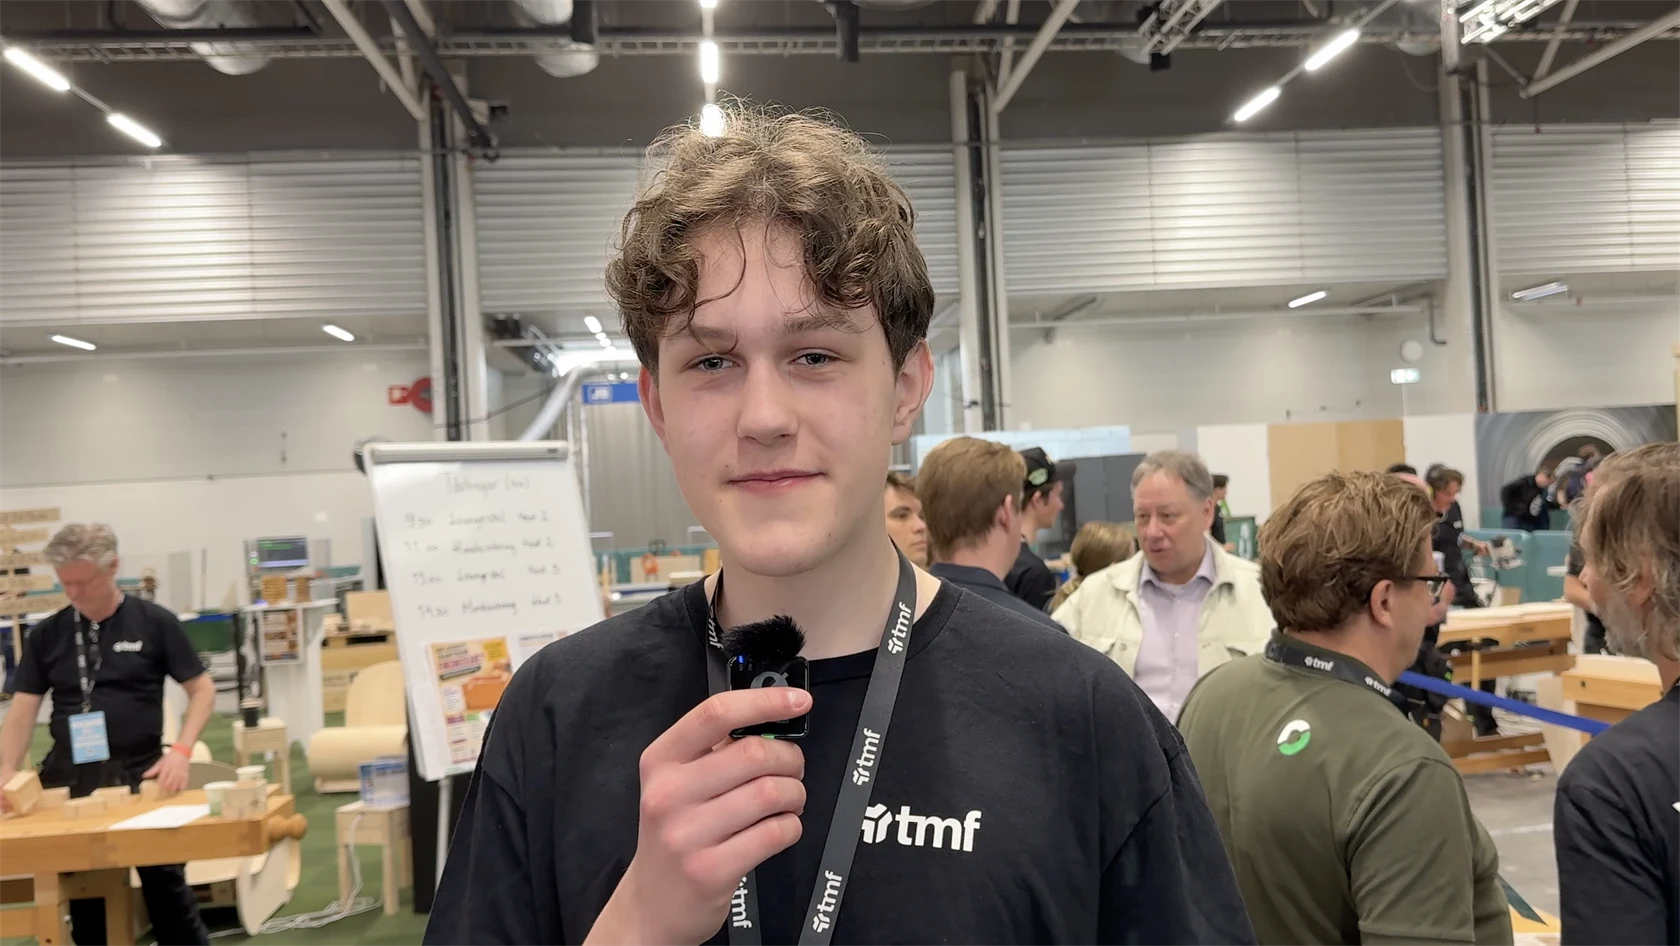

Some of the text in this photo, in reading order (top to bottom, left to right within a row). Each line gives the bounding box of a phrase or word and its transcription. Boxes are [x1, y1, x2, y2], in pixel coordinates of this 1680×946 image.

[891, 602, 911, 639] tmf
[1312, 658, 1334, 671] tmf
[856, 728, 880, 767] tmf
[895, 805, 982, 852] tmf
[731, 887, 752, 929] tmf
[817, 870, 842, 913] tmf
